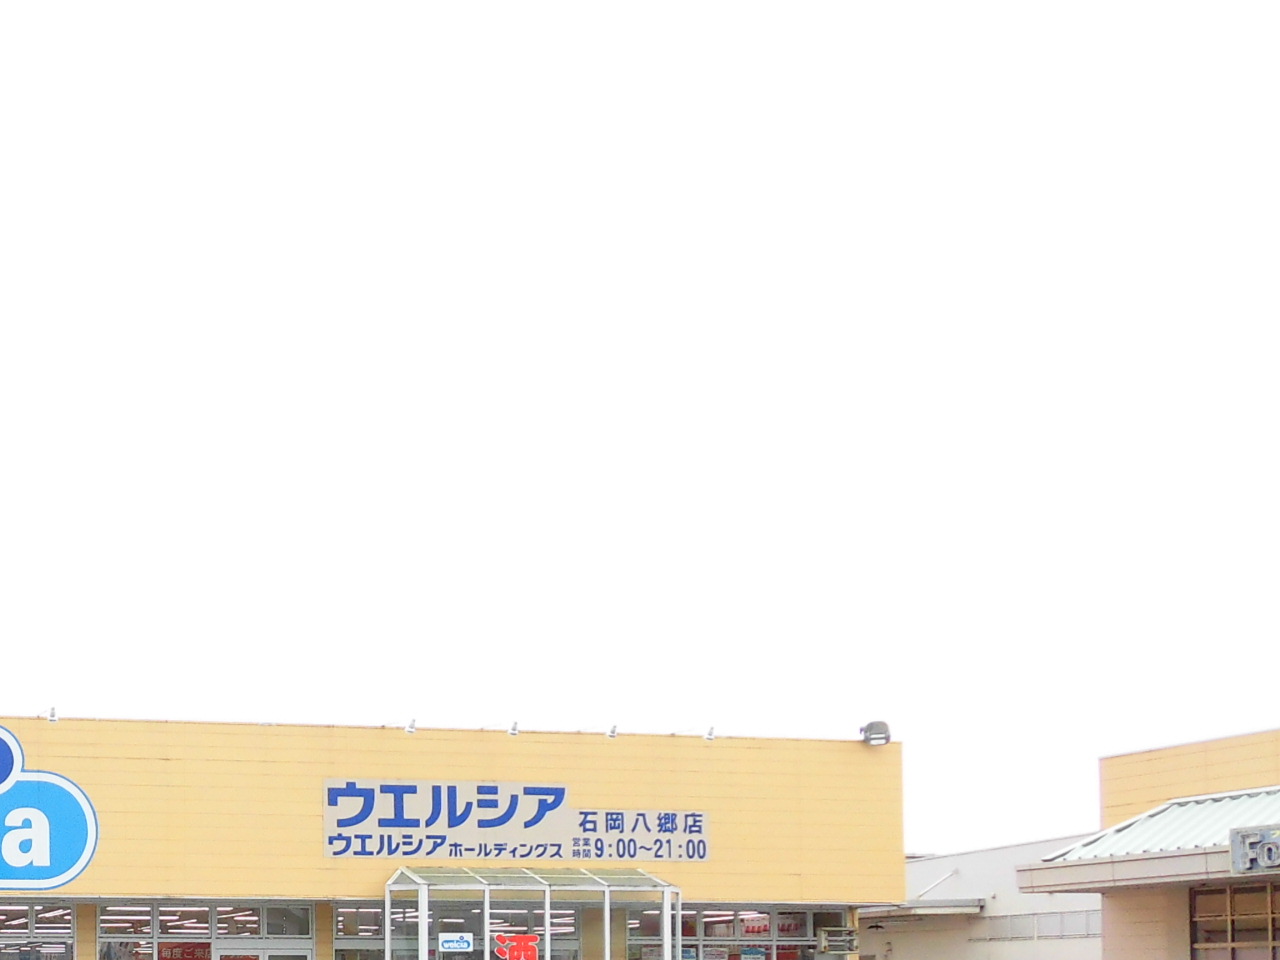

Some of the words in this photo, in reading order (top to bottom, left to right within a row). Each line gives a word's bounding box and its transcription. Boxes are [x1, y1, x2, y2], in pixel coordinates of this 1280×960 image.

[327, 782, 566, 829] ウエルシア
[578, 811, 704, 834] 石岡八郷店
[443, 936, 469, 949] welcia
